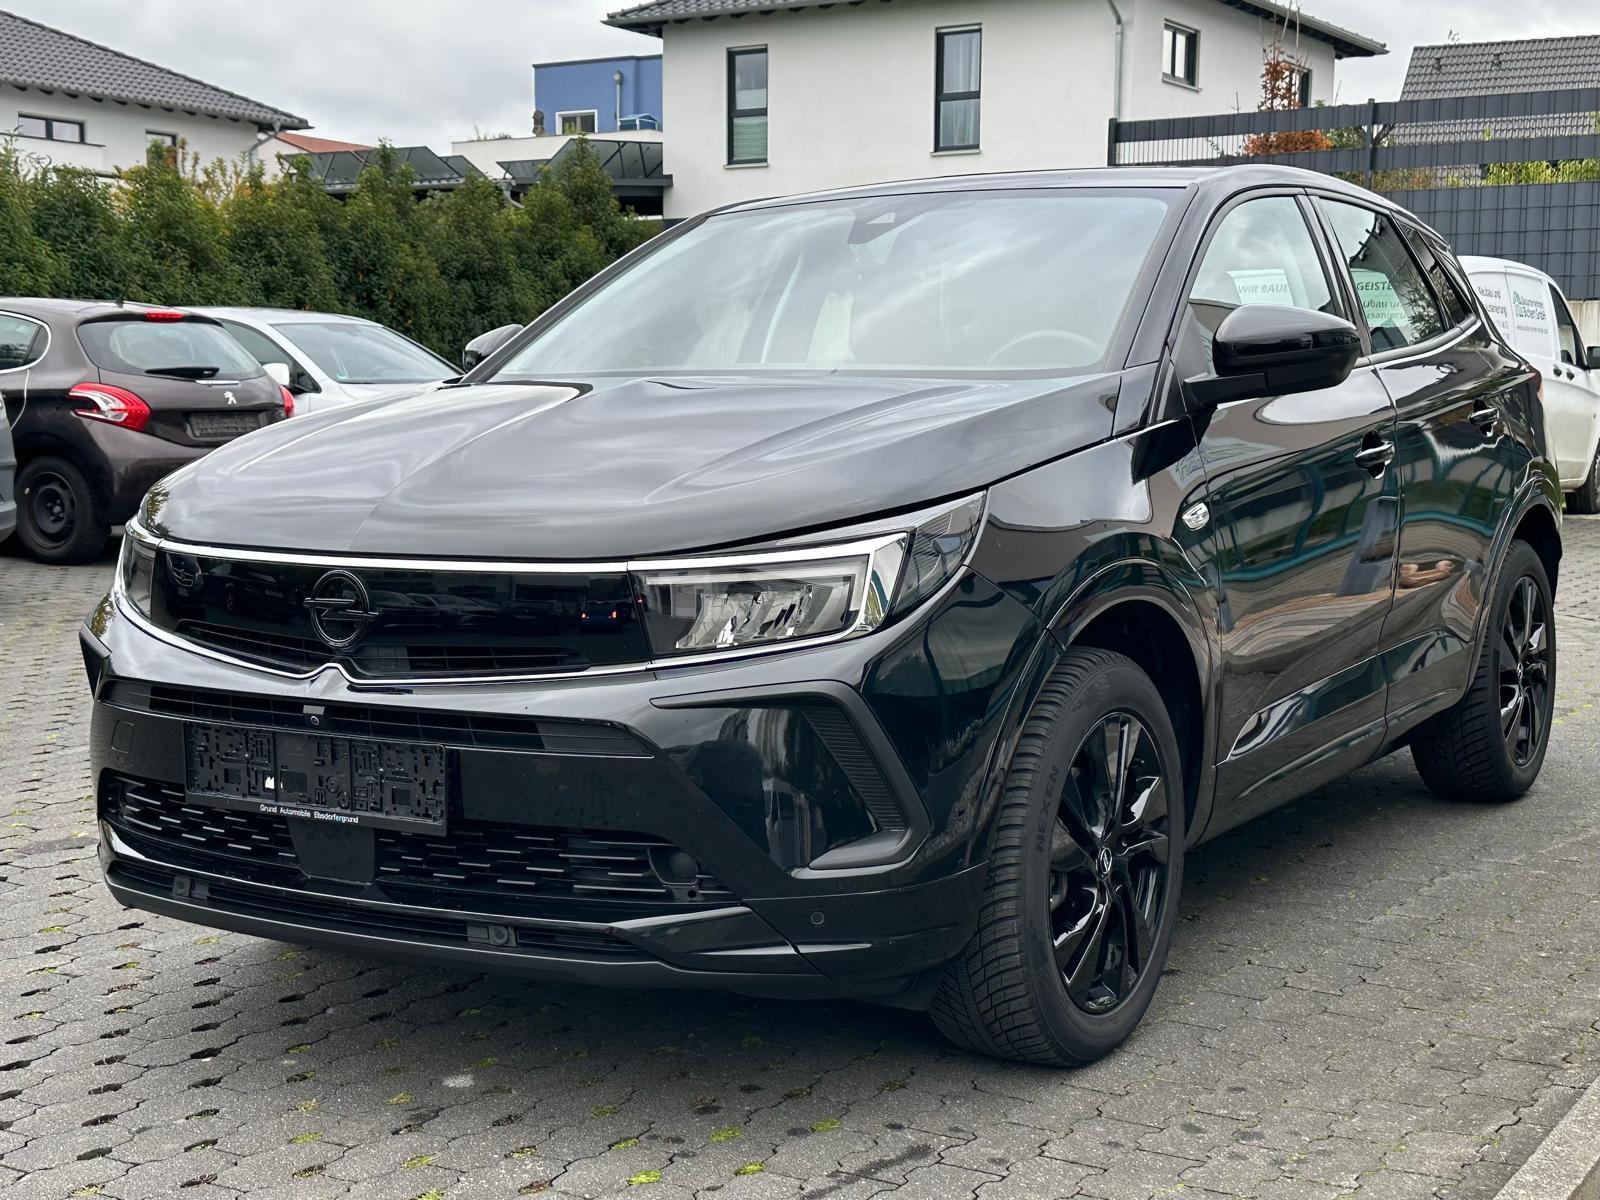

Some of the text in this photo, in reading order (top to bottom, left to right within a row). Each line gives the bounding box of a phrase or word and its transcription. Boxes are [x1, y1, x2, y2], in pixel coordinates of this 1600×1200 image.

[1238, 284, 1258, 294] WIR
[259, 803, 359, 824] Grund Automobile Ebsdorfergrund
[1035, 763, 1060, 853] NEXEN
